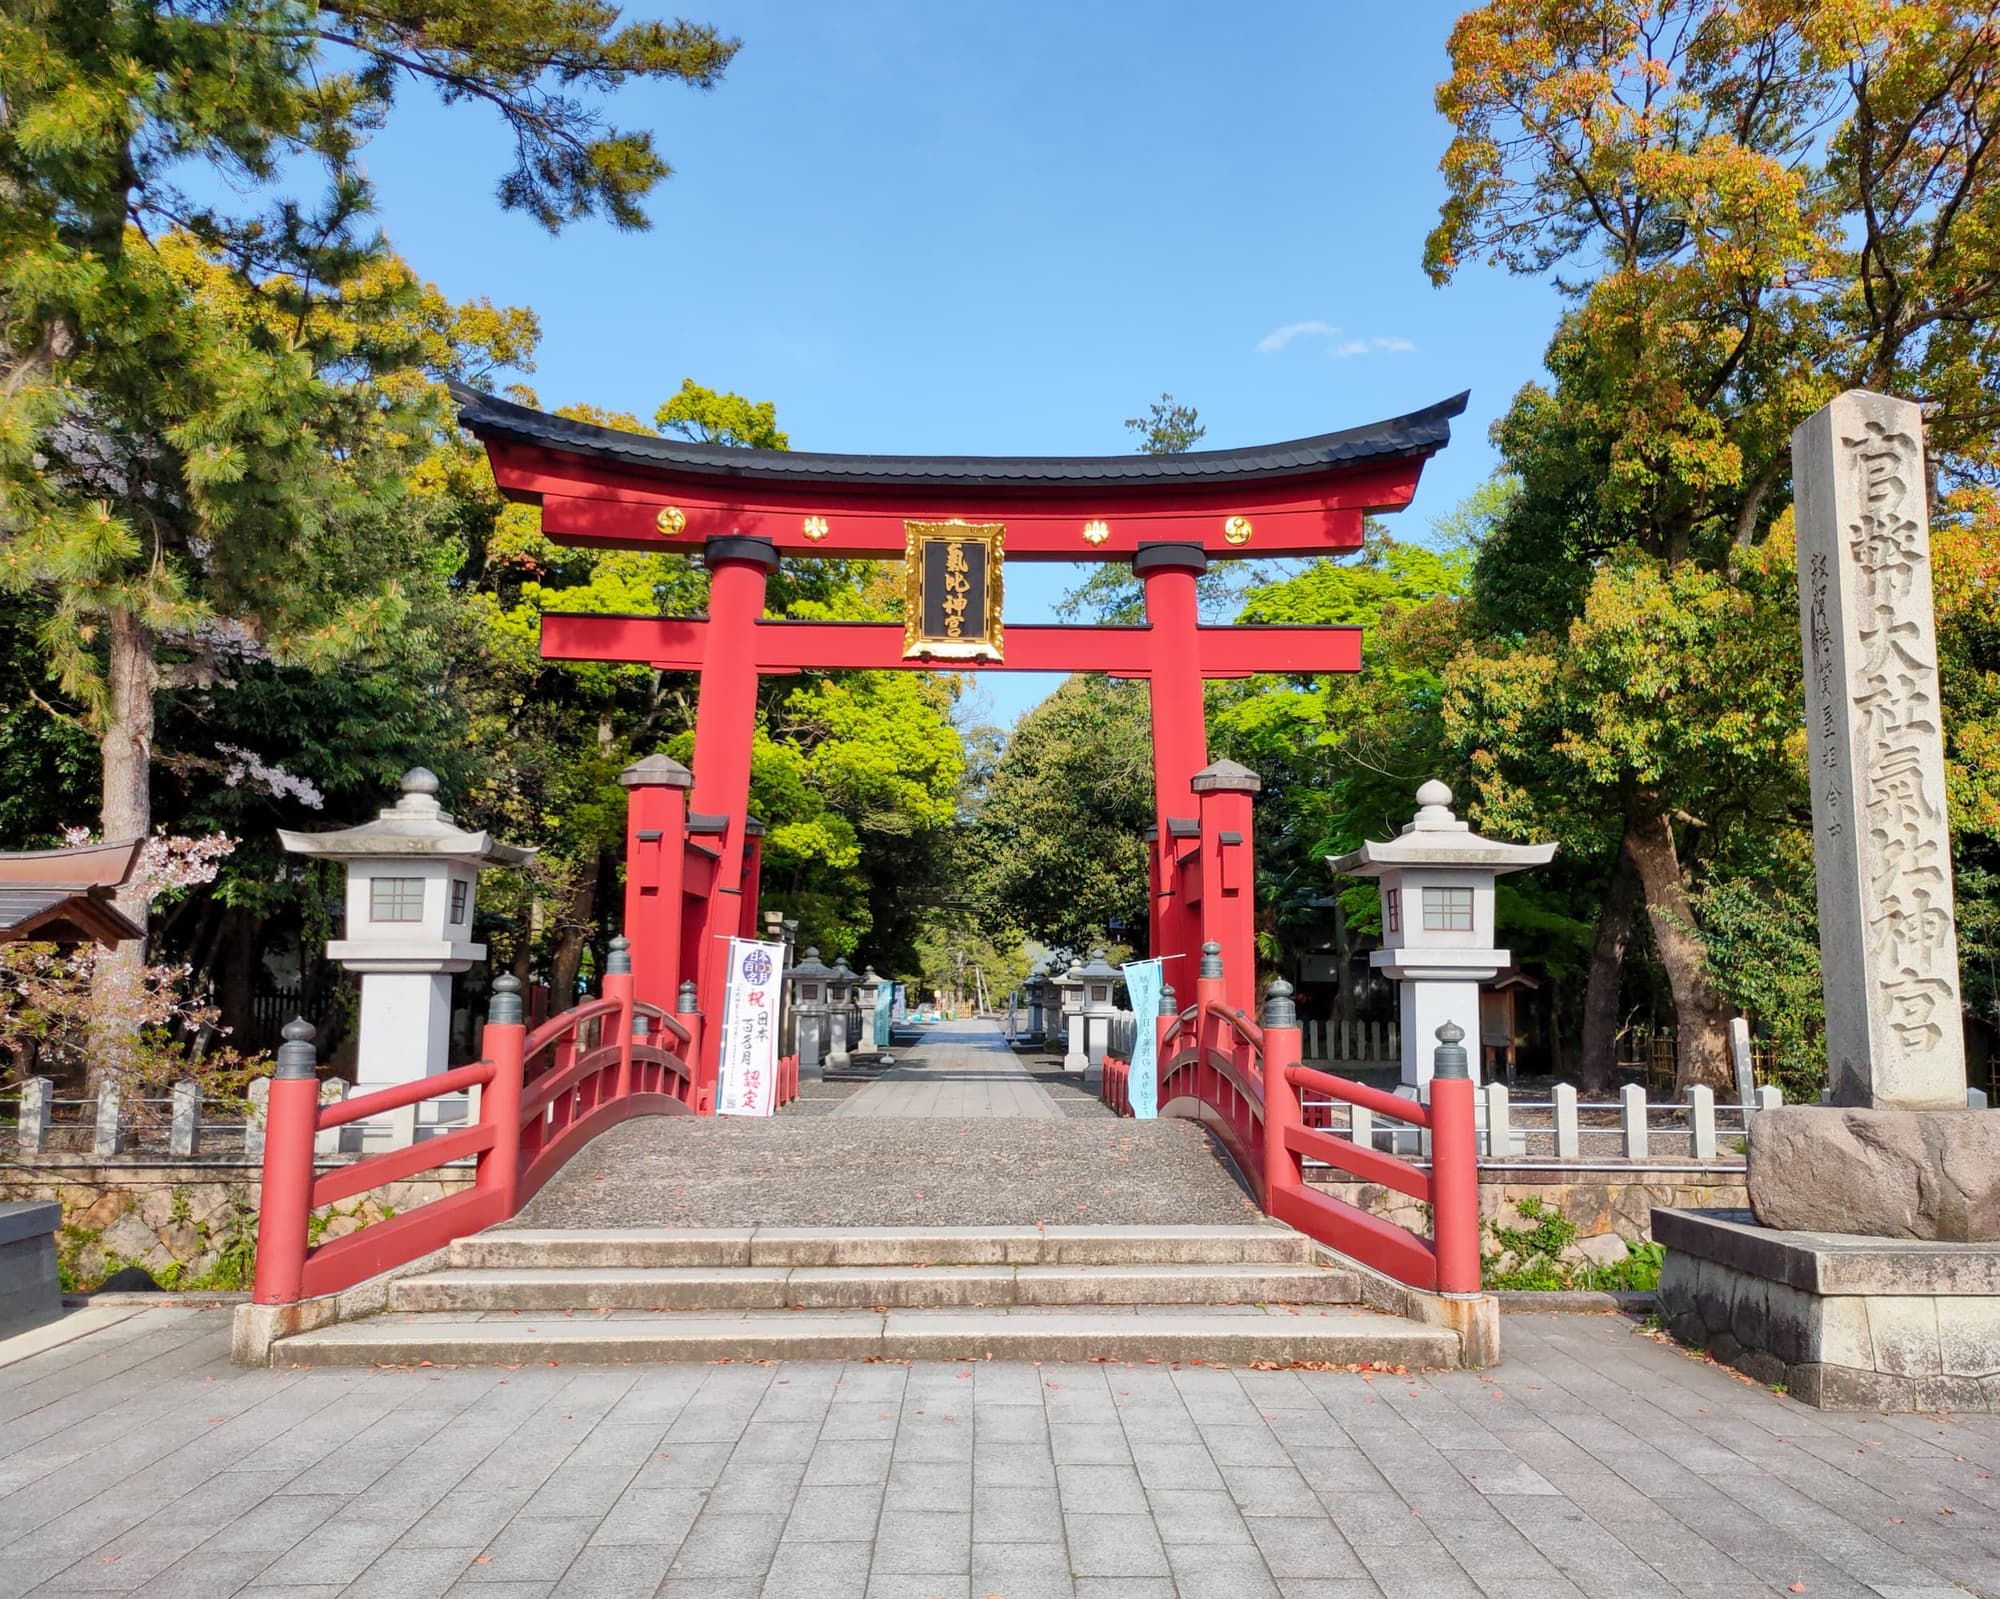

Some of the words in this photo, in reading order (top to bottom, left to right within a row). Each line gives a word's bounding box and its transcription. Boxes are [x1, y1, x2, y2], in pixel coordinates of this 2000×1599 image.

[1841, 421, 1953, 1056] 官幣大社氣比神宮
[747, 988, 765, 1007] 祝
[755, 1011, 769, 1043] 日本
[741, 1068, 761, 1109] 認定
